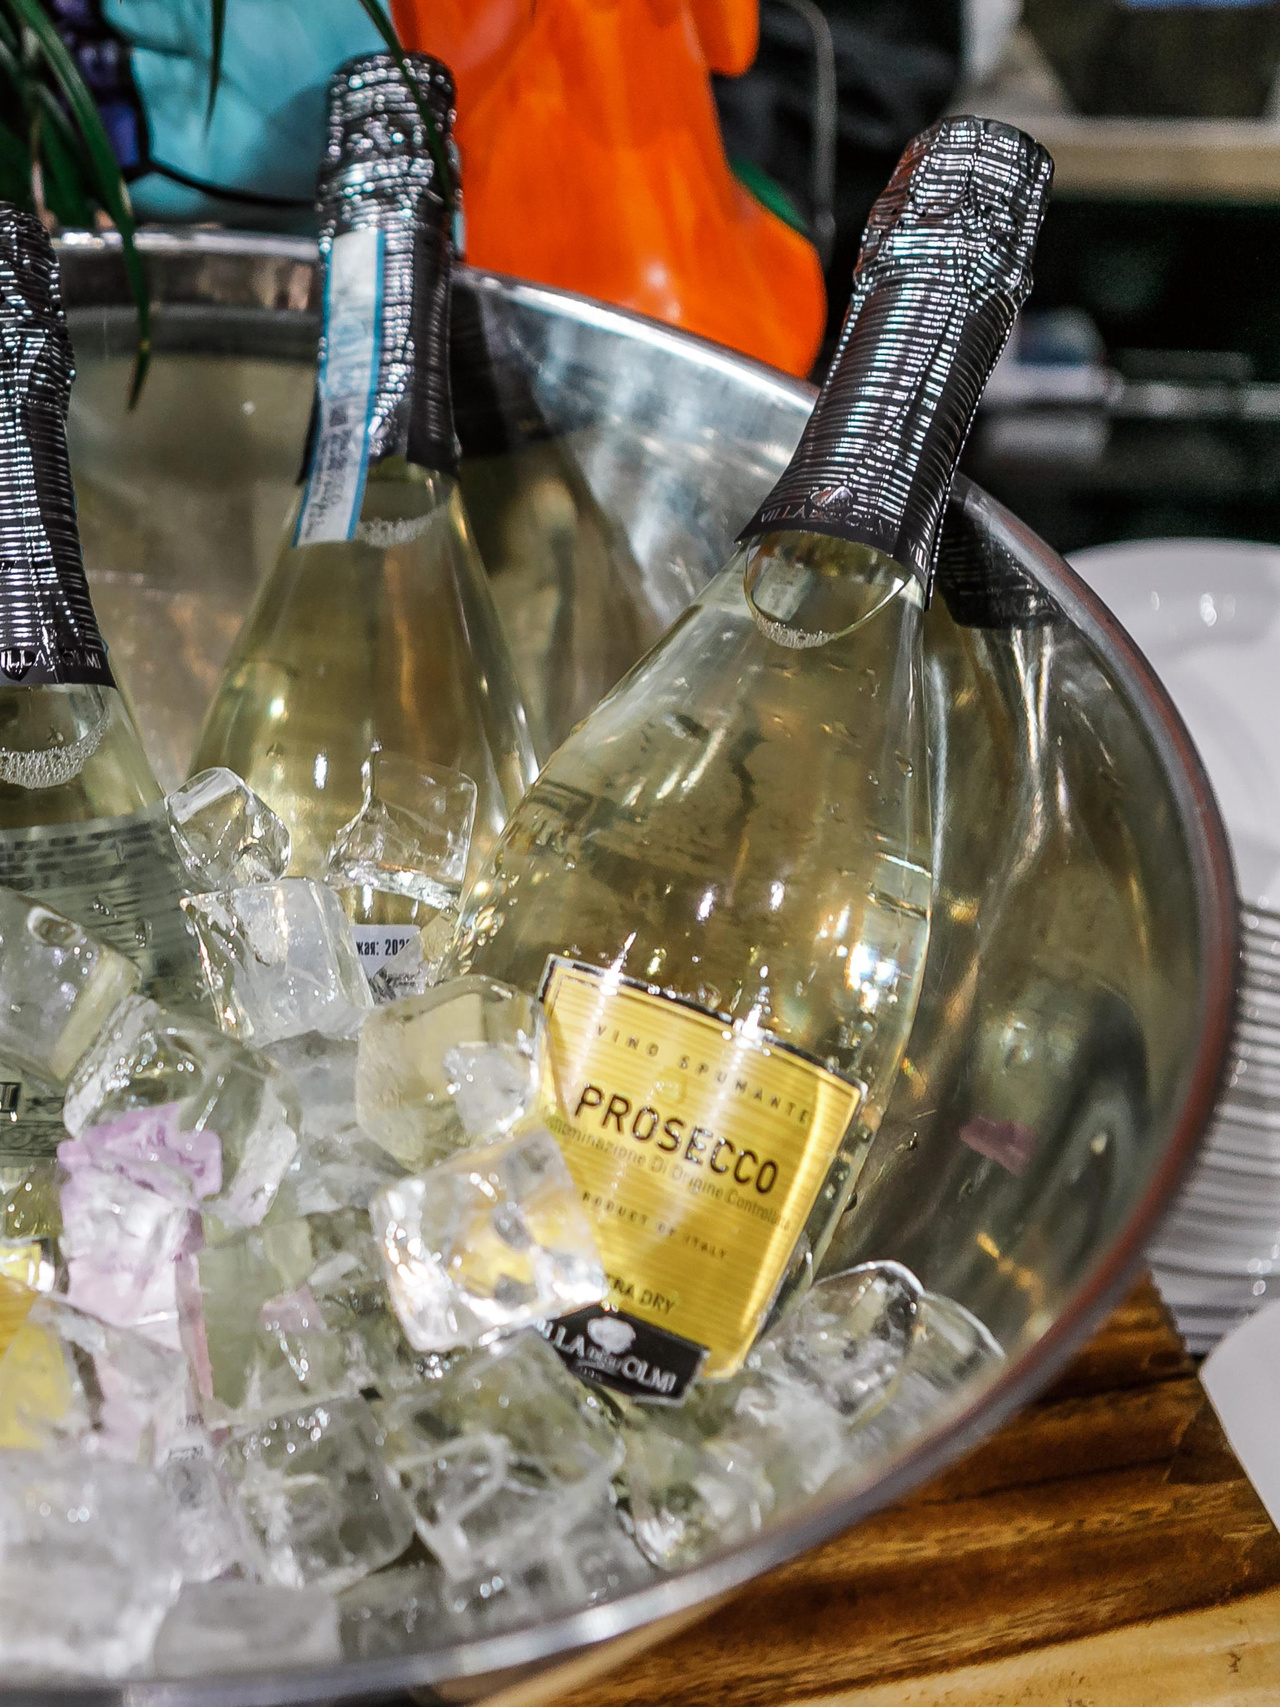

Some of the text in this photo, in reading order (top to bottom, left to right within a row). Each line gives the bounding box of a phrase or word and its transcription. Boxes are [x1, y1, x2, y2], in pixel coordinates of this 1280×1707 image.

[597, 1023, 811, 1125] VINO SPUMANTE
[574, 1083, 778, 1195] PROSECCO
[581, 1190, 648, 1223] RODUCT
[639, 1288, 675, 1316] DRY
[621, 1355, 677, 1393] OLMI
